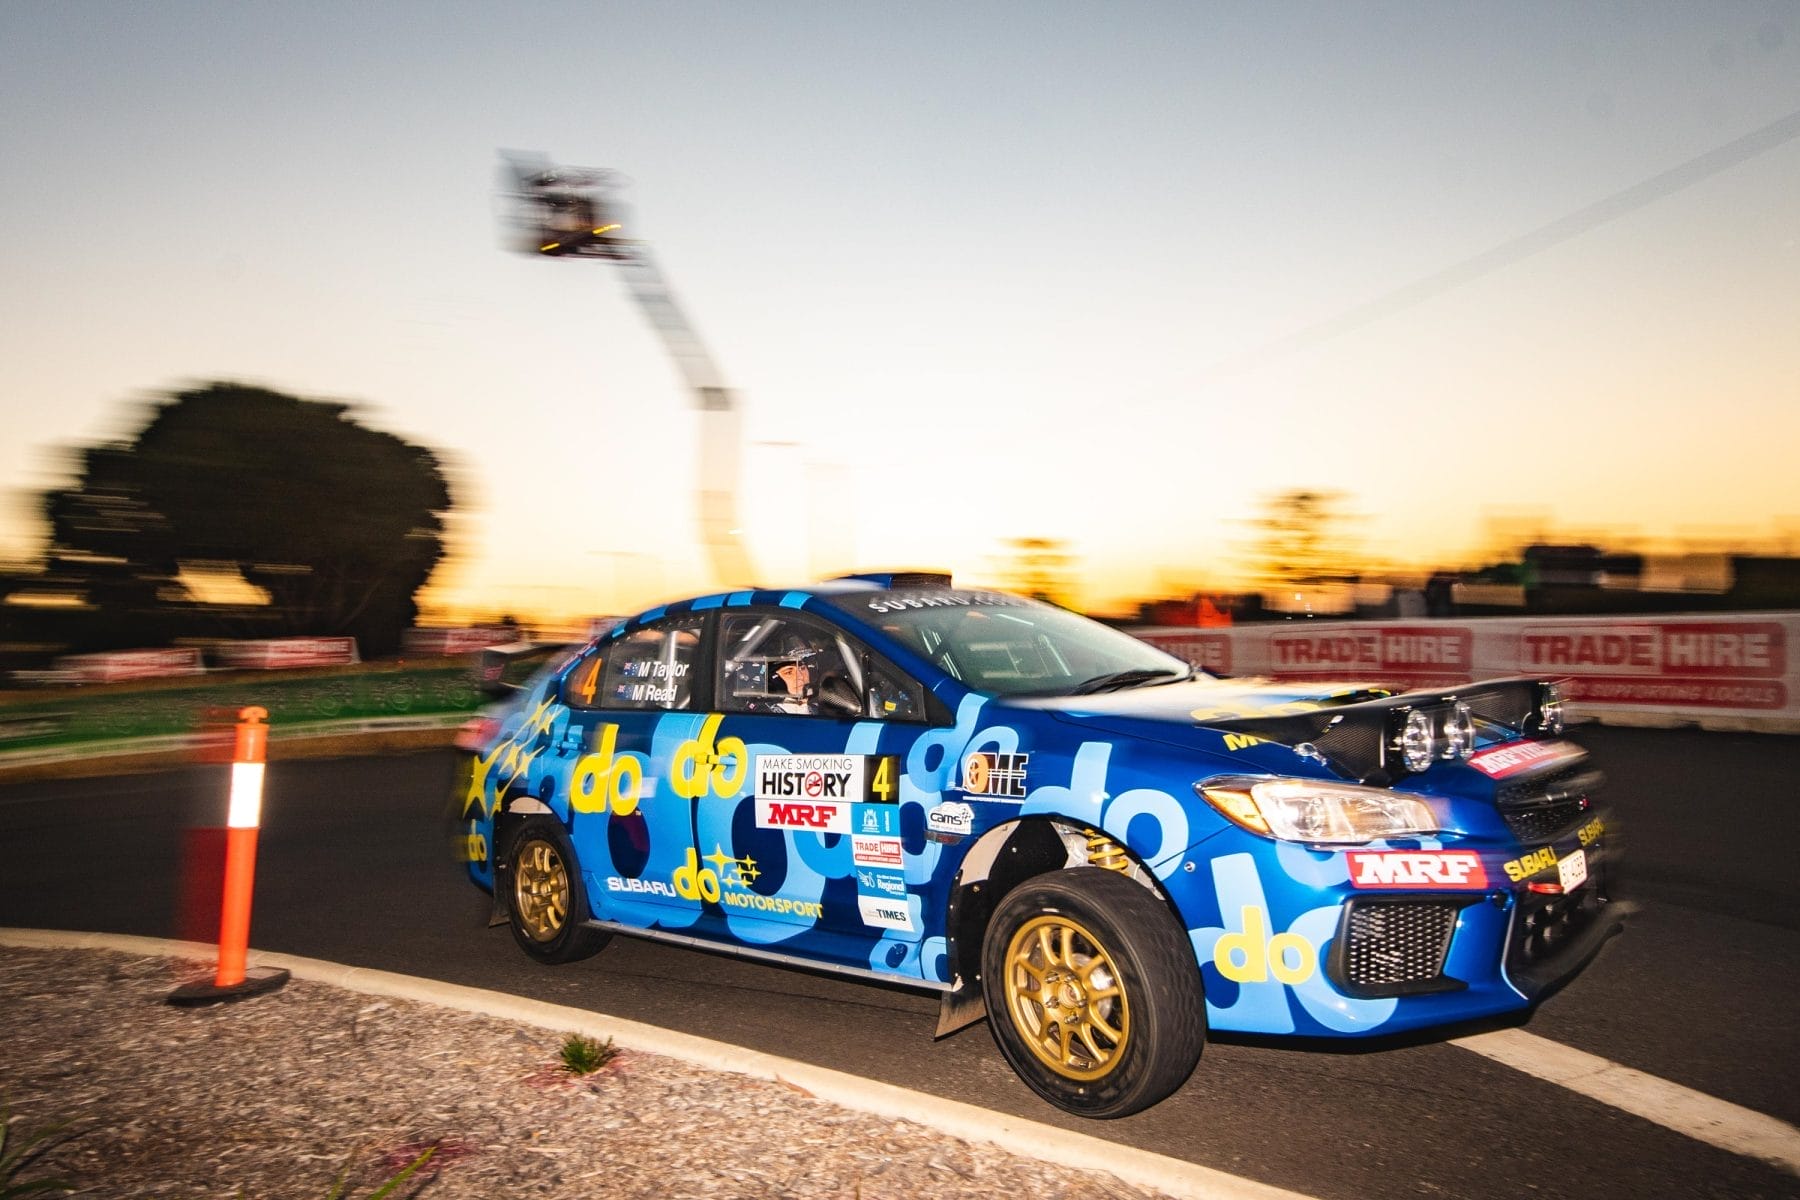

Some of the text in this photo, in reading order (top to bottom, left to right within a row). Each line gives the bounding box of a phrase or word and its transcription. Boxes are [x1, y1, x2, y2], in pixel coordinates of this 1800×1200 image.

[1273, 635, 1462, 664] TRADE HIRE
[1524, 632, 1771, 668] TRADE HIRE
[582, 658, 602, 704] 4
[638, 661, 689, 681] M Taylor
[632, 684, 678, 702] M Read
[569, 723, 643, 816] do
[671, 713, 747, 798] do
[763, 758, 853, 771] MAKE SMOKING
[872, 757, 890, 802] 4
[768, 803, 837, 828] MRF
[930, 812, 963, 826] cams
[855, 841, 880, 853] TRADE
[607, 847, 721, 904] SUBARU do
[1354, 853, 1478, 886] MRF
[1503, 846, 1558, 882] SUBARU
[724, 892, 824, 919] MOTORSPORT
[876, 908, 907, 922] TIMES
[1213, 904, 1316, 986] do
